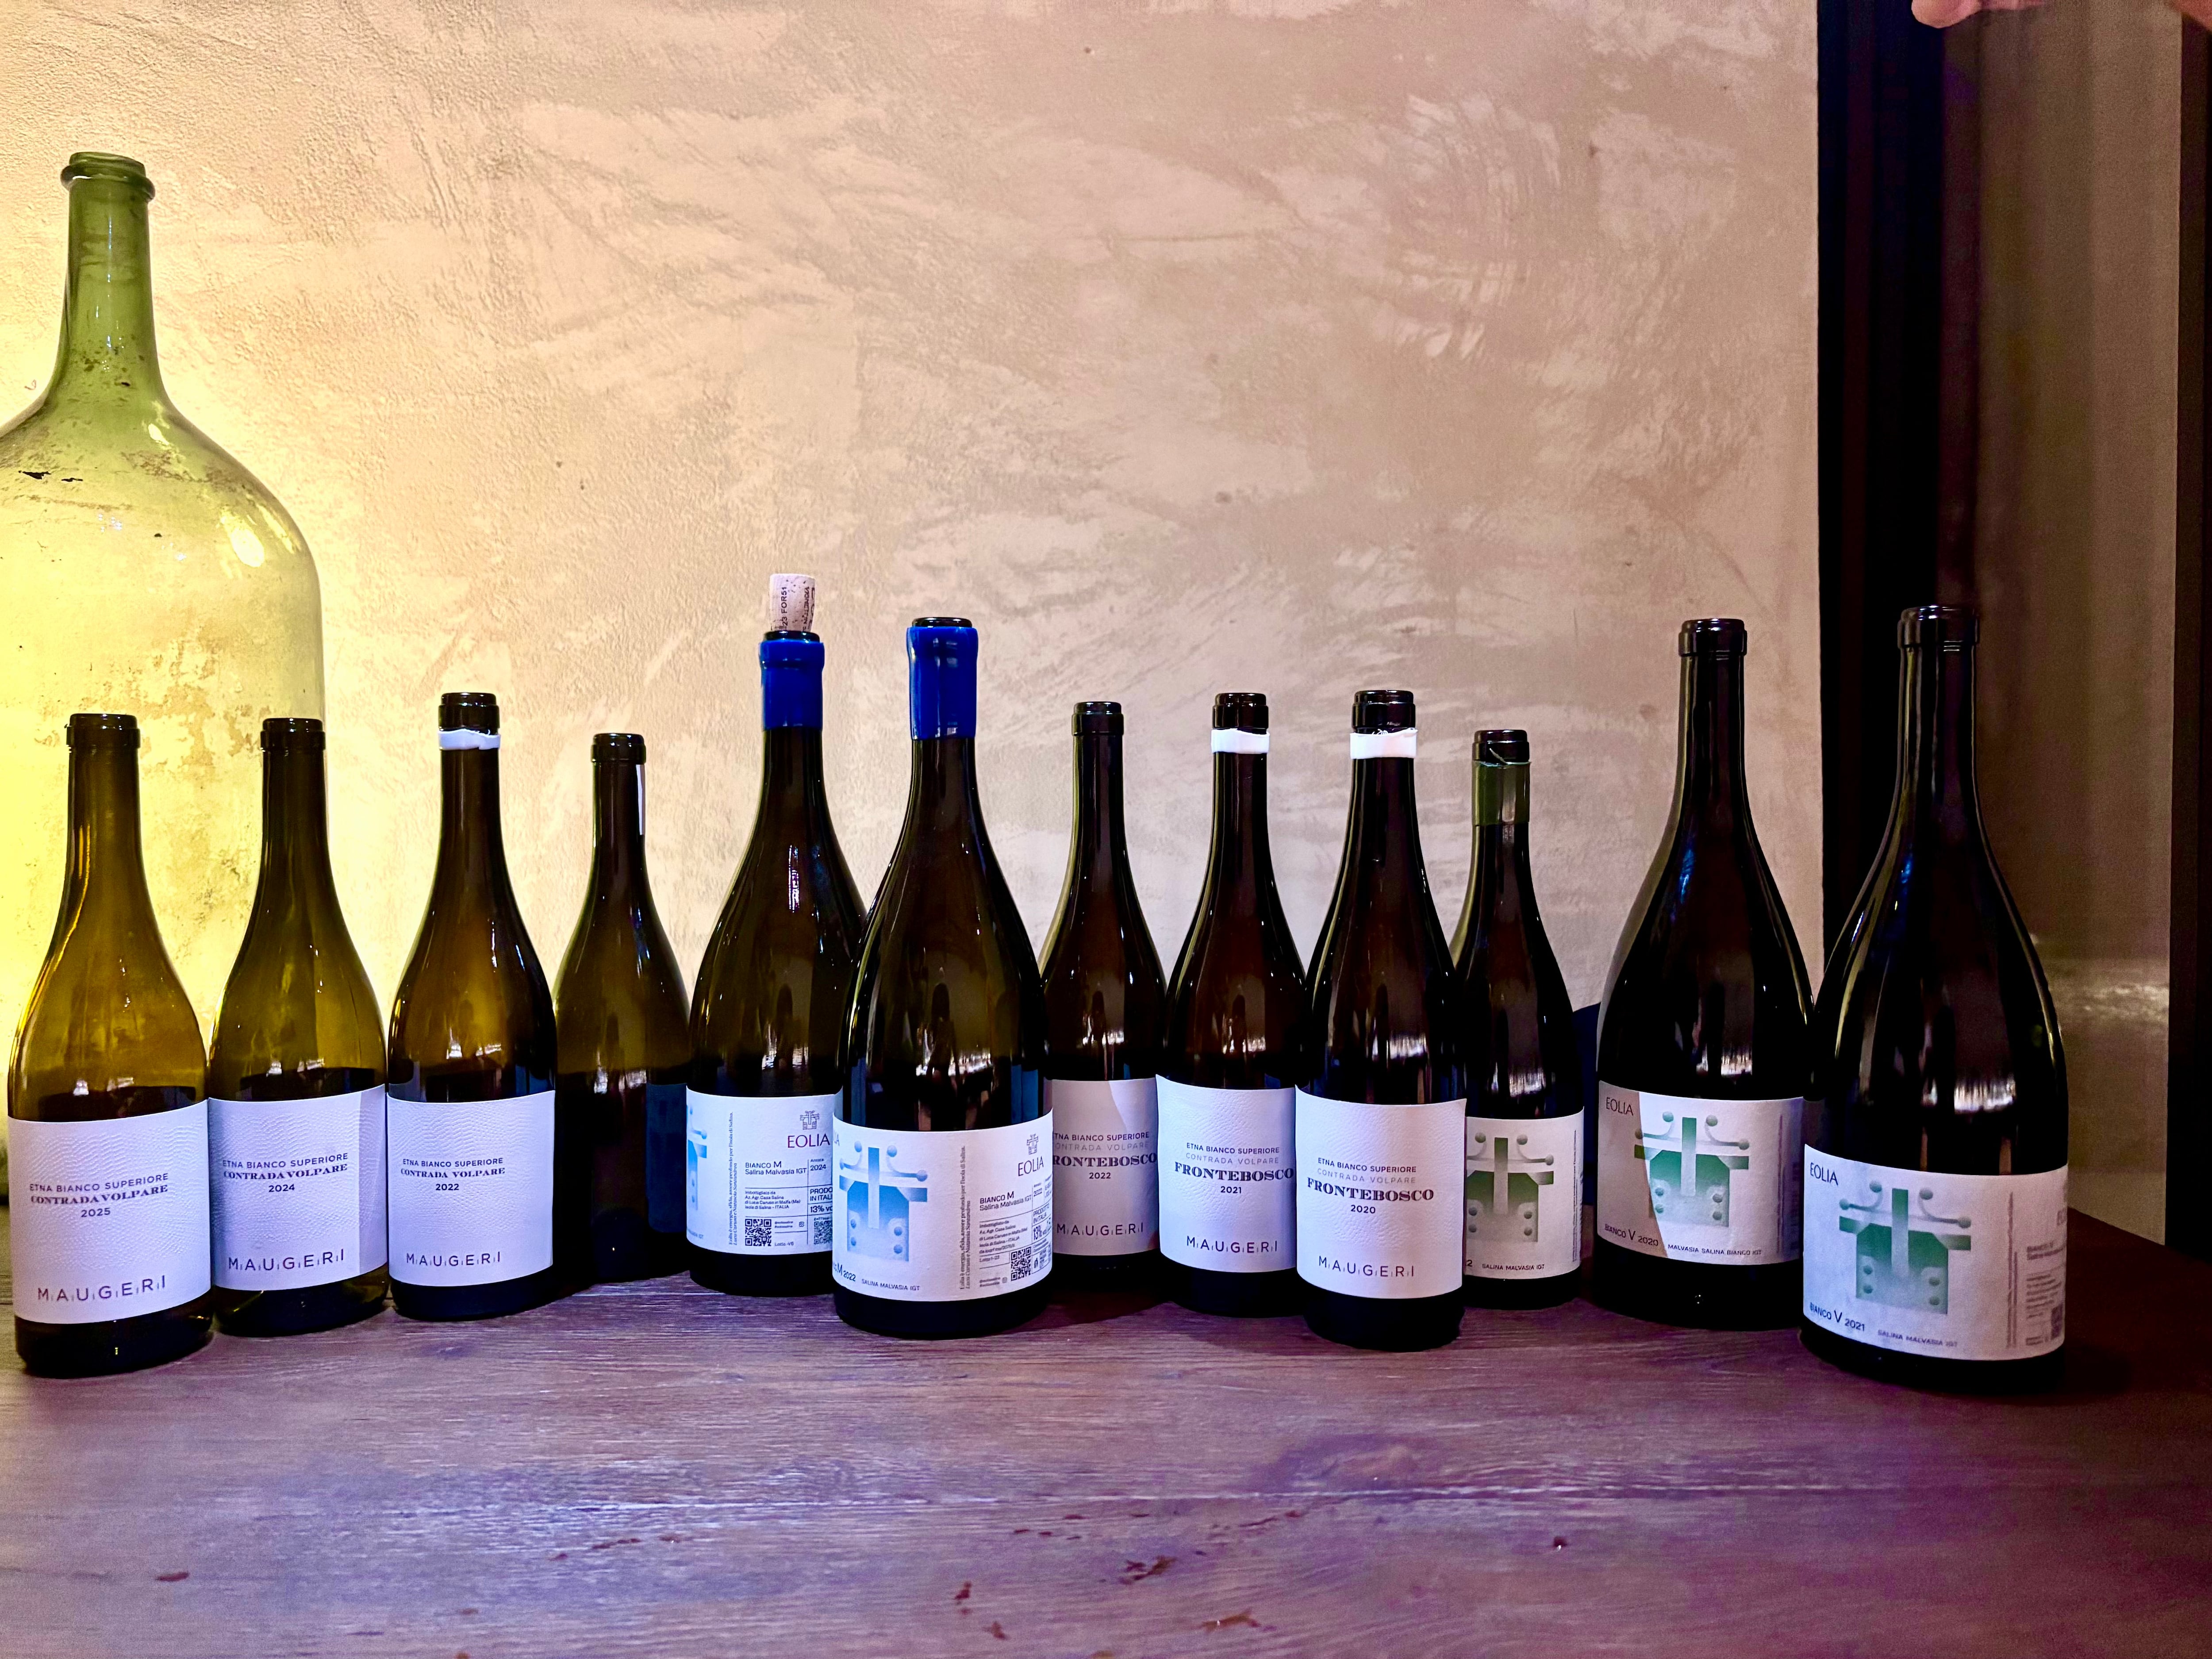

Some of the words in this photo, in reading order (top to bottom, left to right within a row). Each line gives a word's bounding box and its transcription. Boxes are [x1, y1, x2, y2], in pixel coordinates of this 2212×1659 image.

[1606, 1097, 1633, 1116] EOLIA
[787, 1133, 830, 1148] EOLIA
[1107, 1131, 1149, 1141] SUPERIORE
[1107, 1141, 1149, 1151] VOLPARE
[1186, 1142, 1204, 1152] ETNA
[1206, 1145, 1235, 1154] BIANCO
[291, 1153, 348, 1167] SUPERIORE
[455, 1158, 503, 1167] SUPERIORE
[1186, 1152, 1233, 1165] CONTRADA
[1237, 1156, 1279, 1165] VOLPARE
[1318, 1157, 1335, 1167] ETNA
[1337, 1161, 1367, 1172] BIANCO
[286, 1164, 348, 1178] VOLPARE
[401, 1168, 449, 1178] CONTRADA
[452, 1168, 505, 1178] VOLPARE
[1018, 1156, 1044, 1177] EOLIA
[1175, 1162, 1294, 1182] FRONTEBOSCO
[1317, 1168, 1365, 1182] CONTRADA
[1370, 1176, 1416, 1184] VOLPARE
[1810, 1162, 1839, 1186] EOLIA
[30, 1183, 52, 1192] ETNA
[56, 1183, 100, 1192] BIANCO
[105, 1173, 169, 1190] SUPERIORE
[269, 1184, 295, 1192] 2024
[1307, 1177, 1434, 1202] FRONTEBOSCO
[31, 1195, 99, 1204] CONTRADA
[101, 1185, 168, 1202] VOLPARE
[1220, 1186, 1242, 1194] 2021
[980, 1195, 1005, 1204] BIANCO
[1007, 1191, 1014, 1199] M
[1000, 1198, 1024, 1208] Malvasia
[81, 1208, 110, 1217] 2025
[1351, 1204, 1376, 1214] 2020
[1605, 1224, 1626, 1238] BIANCO
[1628, 1229, 1636, 1240] V
[1638, 1235, 1659, 1247] 2020
[1668, 1244, 1699, 1253] MALVASIA
[843, 1270, 856, 1282] 2022
[1810, 1302, 1832, 1320] BIANCO
[1834, 1310, 1843, 1323] V
[1845, 1318, 1865, 1331] 2021
[1878, 1329, 1903, 1340] SALINA
[1906, 1336, 1943, 1346] MALVASIA
